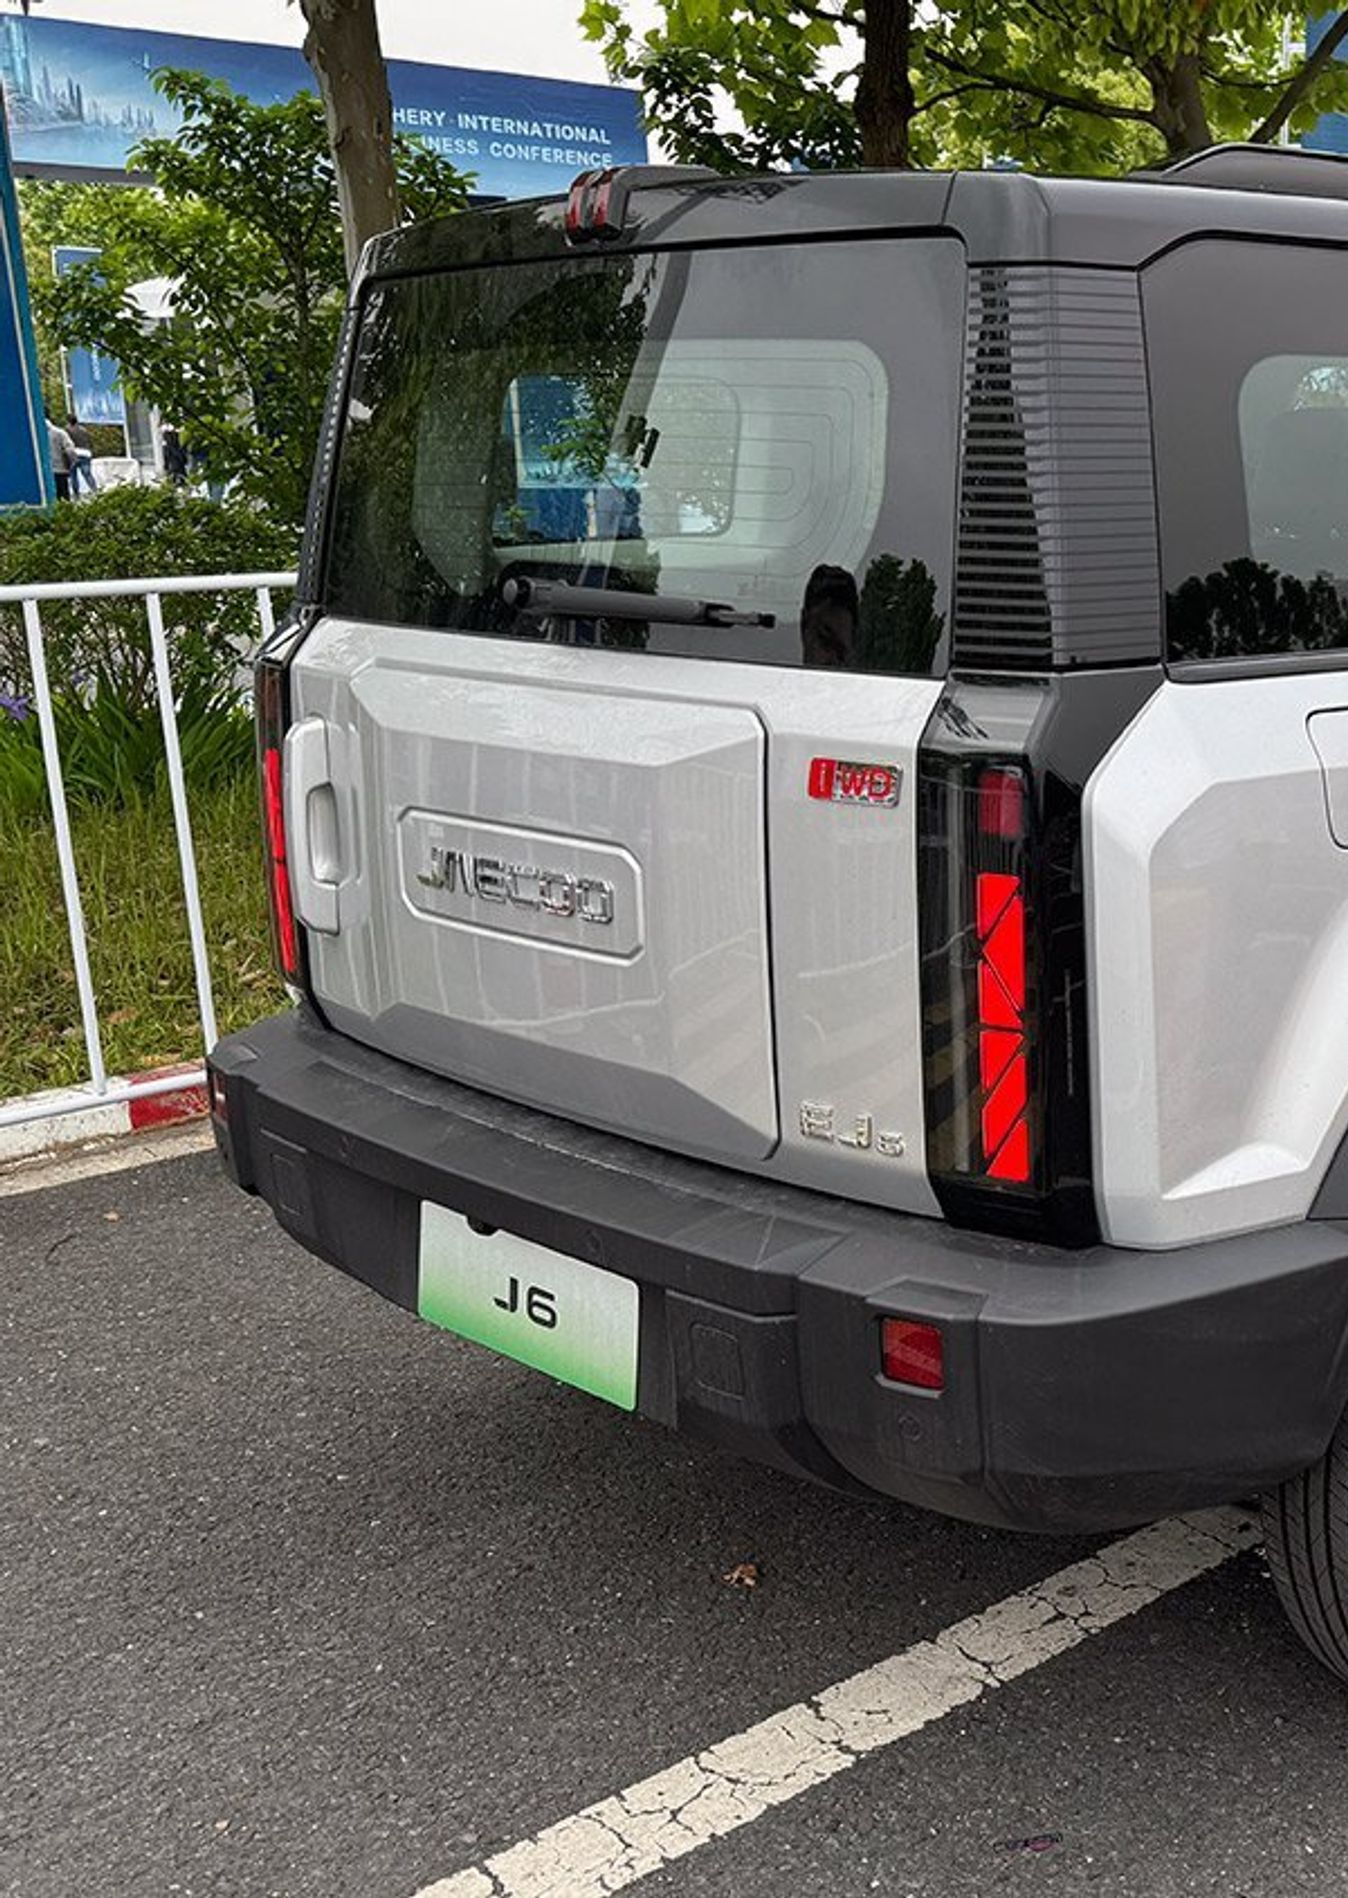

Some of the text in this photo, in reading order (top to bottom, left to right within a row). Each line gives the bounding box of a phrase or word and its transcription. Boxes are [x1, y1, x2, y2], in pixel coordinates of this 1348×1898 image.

[392, 108, 612, 145] HERY INTERNATIONAL
[421, 135, 613, 168] INESS CONFERENCE
[493, 1276, 557, 1329] J6
